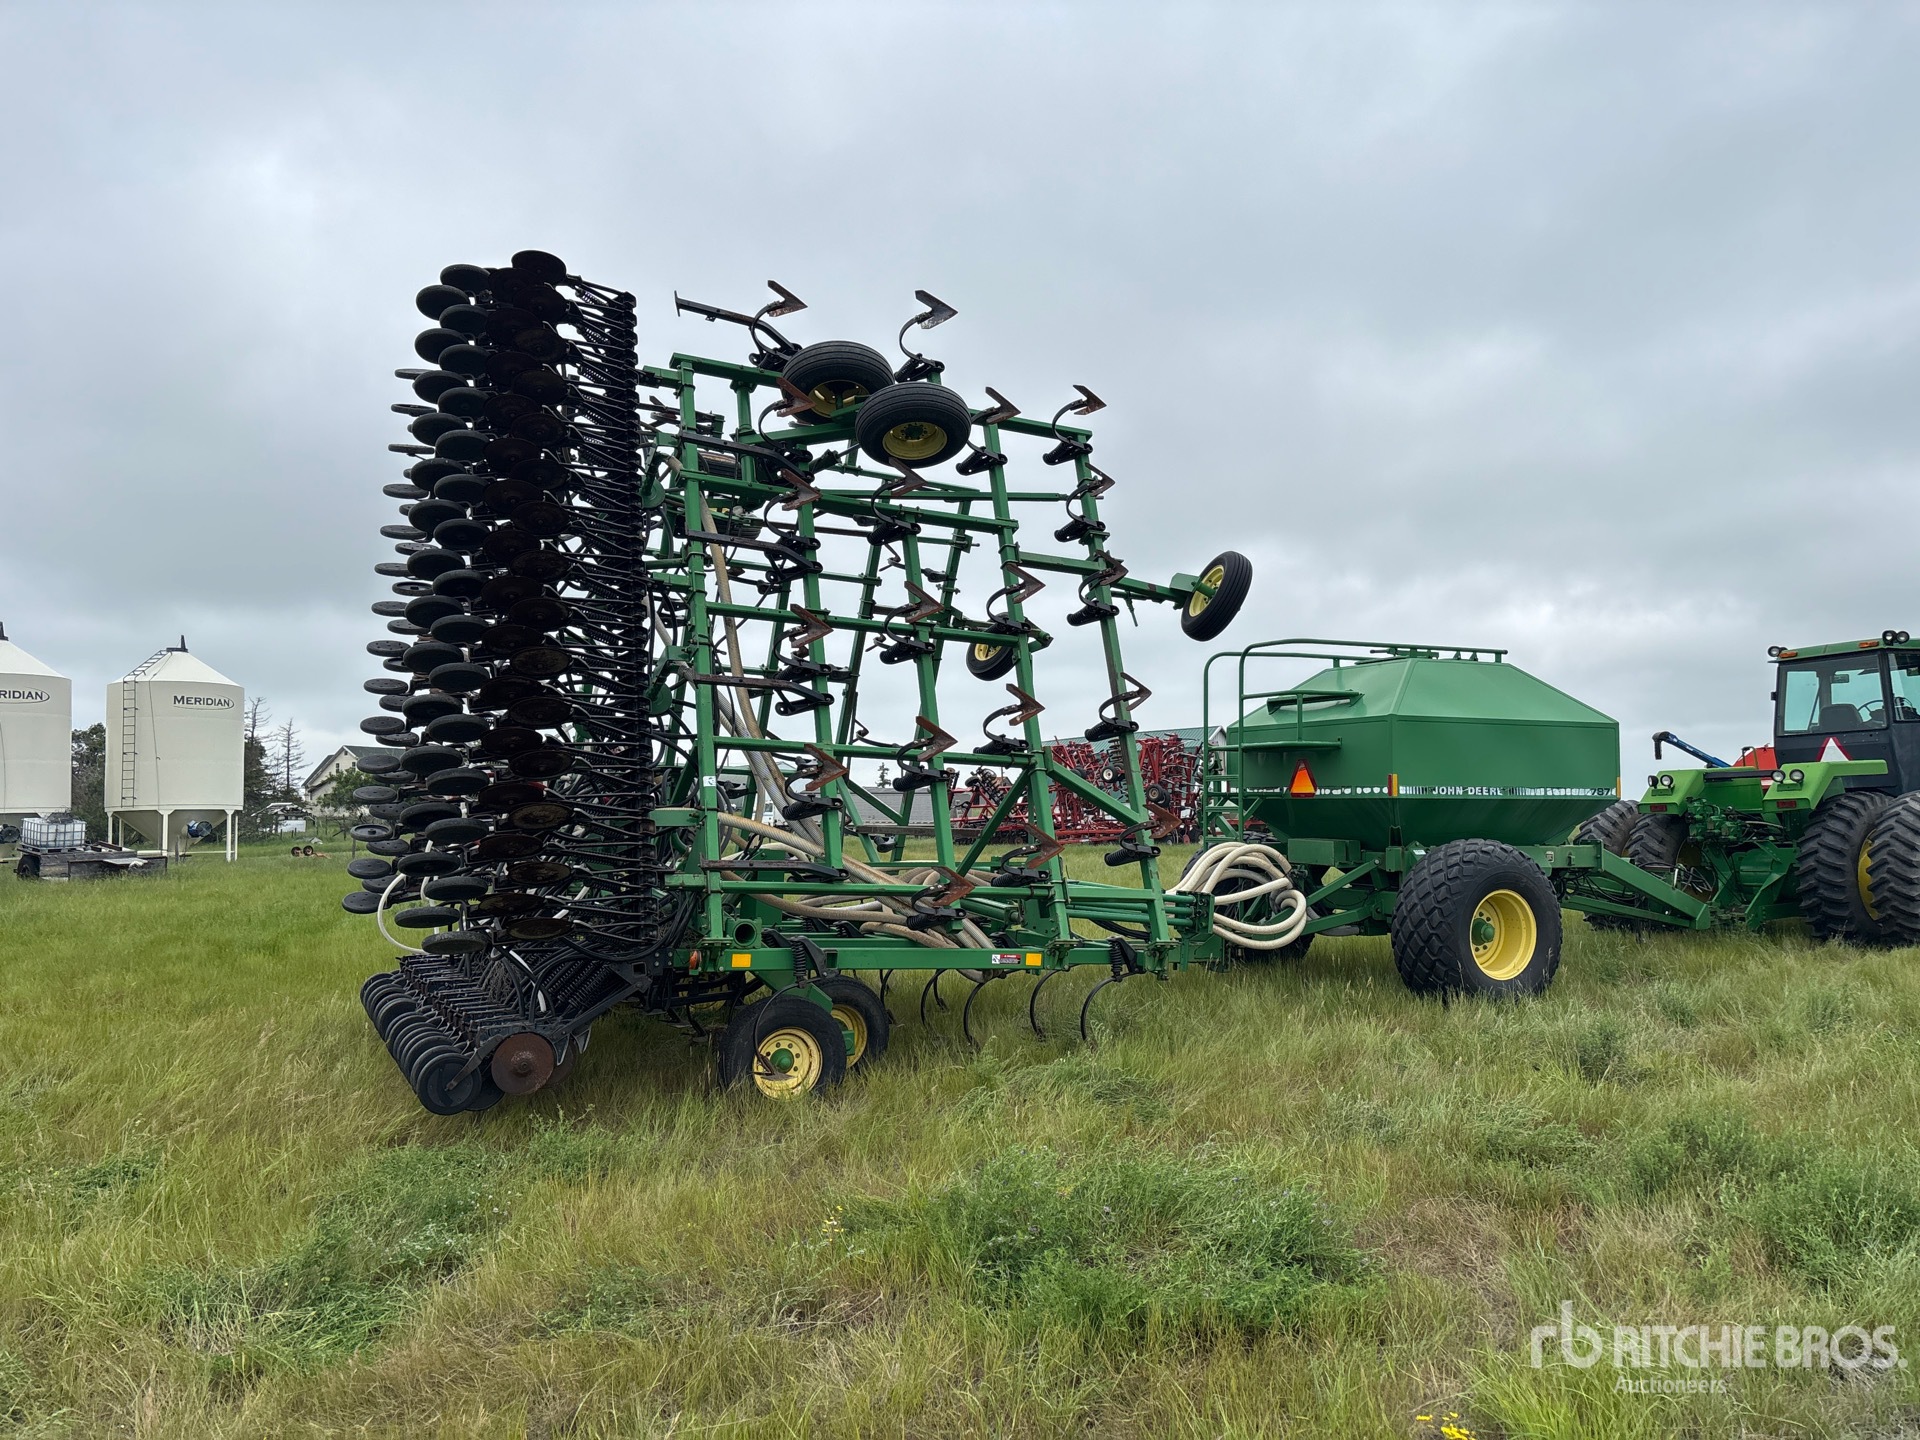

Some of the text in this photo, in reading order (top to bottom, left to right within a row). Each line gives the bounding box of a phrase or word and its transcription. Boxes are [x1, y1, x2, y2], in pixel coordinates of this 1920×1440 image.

[173, 695, 230, 707] MERIDIAN
[1432, 786, 1463, 795] JOHN
[1590, 787, 1610, 796] 787
